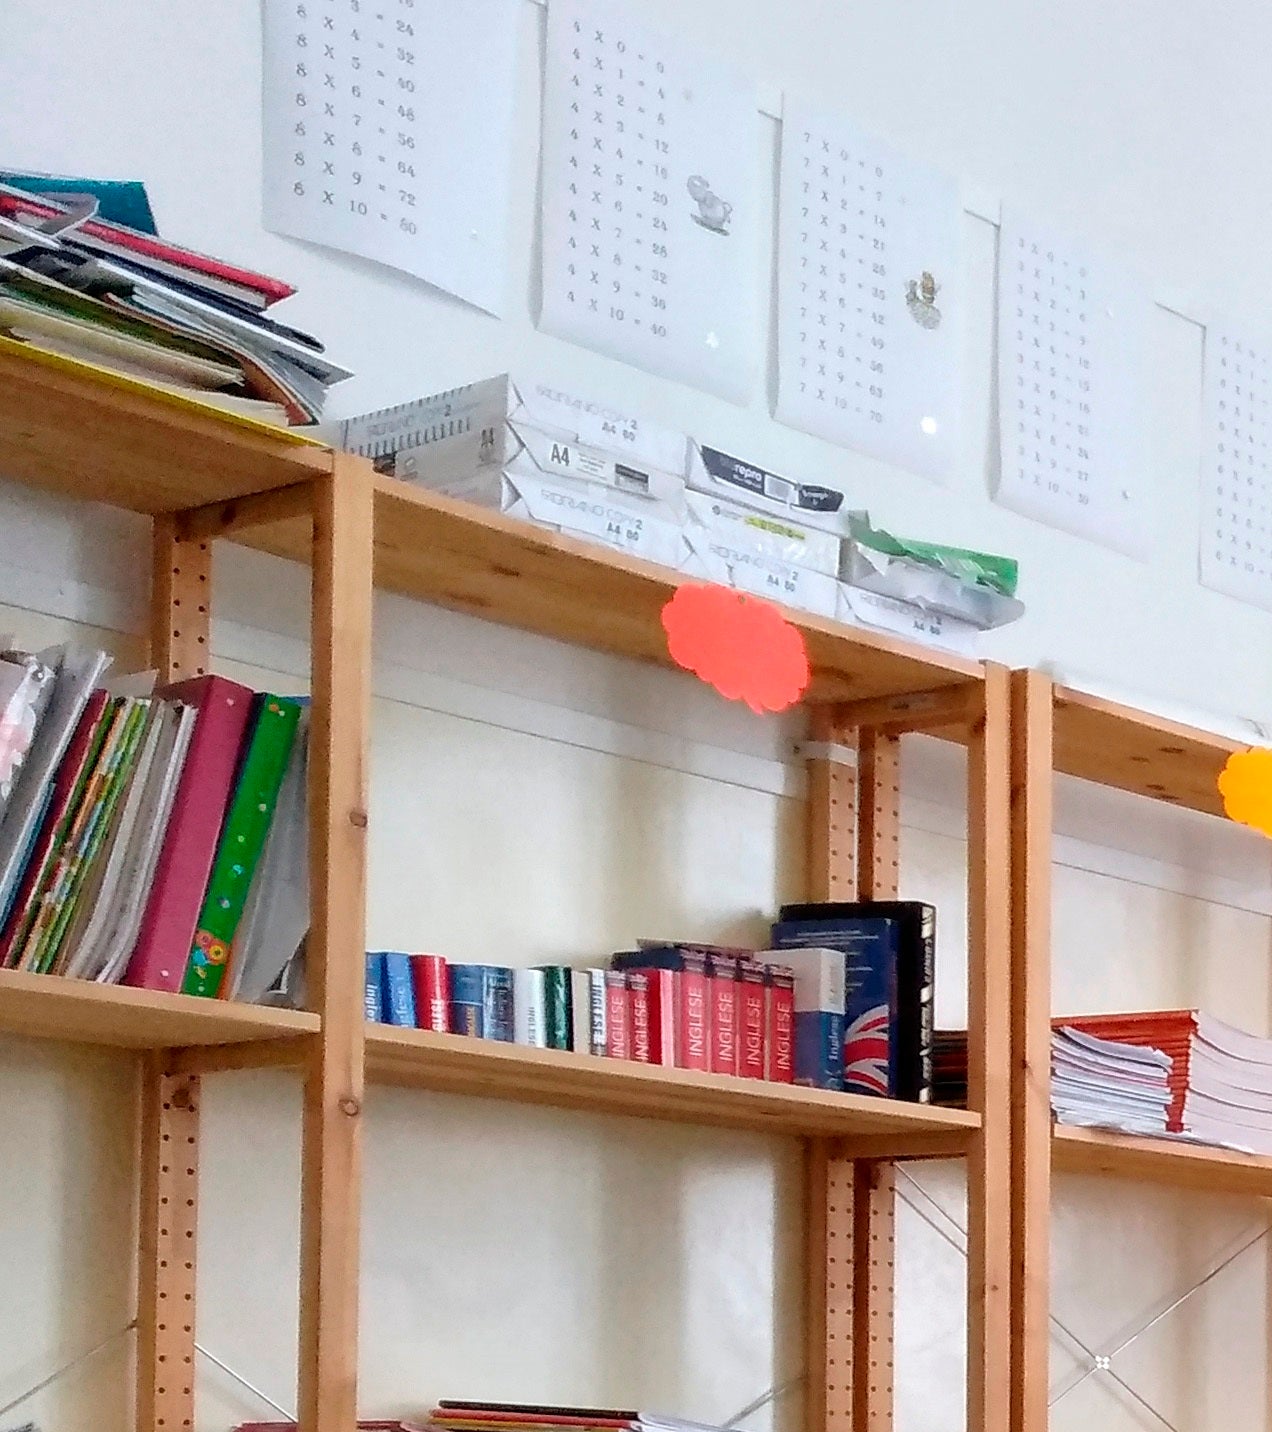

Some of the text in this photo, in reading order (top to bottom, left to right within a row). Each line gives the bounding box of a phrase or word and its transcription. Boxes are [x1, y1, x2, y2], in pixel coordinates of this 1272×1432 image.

[297, 5, 306, 17] 8
[324, 17, 333, 30] X
[352, 29, 359, 40] 4
[297, 34, 307, 47] 8
[324, 45, 334, 59] X
[352, 57, 360, 70] 5
[296, 63, 307, 77] 8
[324, 74, 335, 88] X
[352, 86, 360, 97] 6
[296, 93, 306, 106] 8
[325, 103, 334, 116] X
[354, 114, 361, 126] 7
[295, 122, 415, 177] 8 X 8 64
[294, 152, 415, 206] 8 X 9 72
[294, 182, 304, 196] 8
[323, 191, 334, 204] X
[351, 200, 367, 215] 10
[551, 443, 570, 466] A4
[607, 522, 621, 534] A4
[636, 519, 643, 530] 2
[592, 981, 603, 1045] INGLESE
[612, 995, 626, 1058] INGLESE
[634, 997, 649, 1062] INGLESE
[688, 987, 704, 1058] INGLESE
[719, 991, 734, 1062] INGLESE
[747, 995, 762, 1067] INGLESE
[777, 1002, 792, 1071] INGLESE
